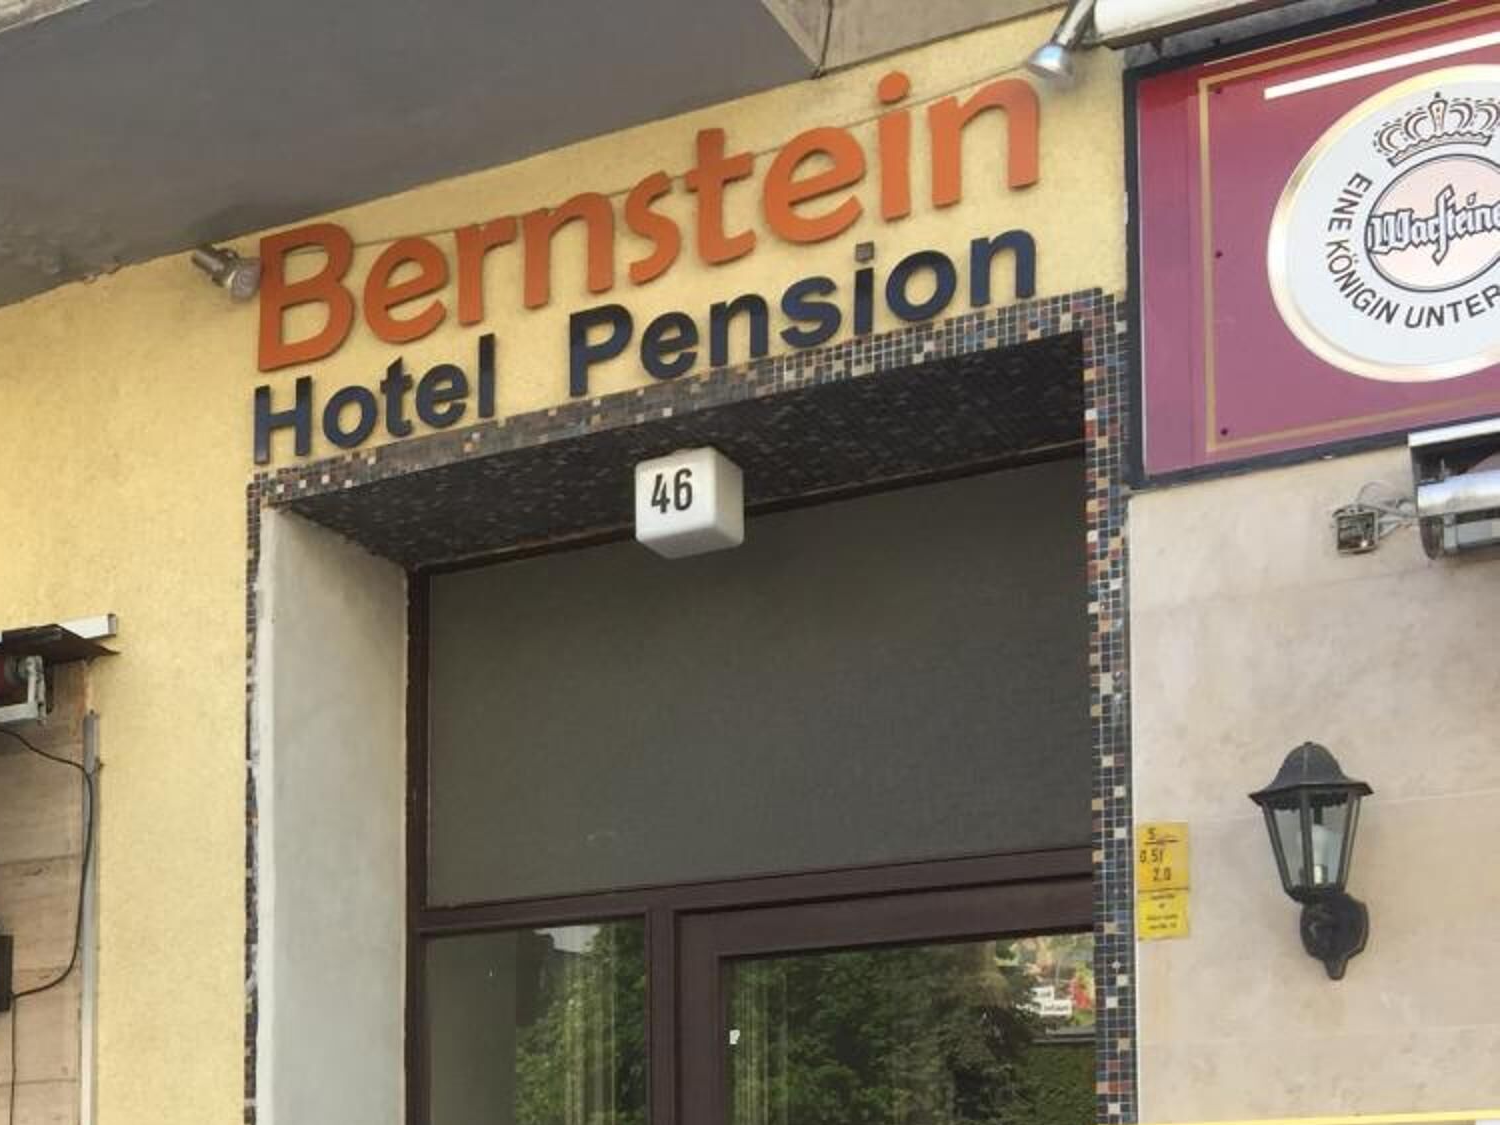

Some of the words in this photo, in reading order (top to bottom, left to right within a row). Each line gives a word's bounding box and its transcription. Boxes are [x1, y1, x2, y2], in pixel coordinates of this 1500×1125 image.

[257, 71, 1041, 372] Bernstein
[1328, 171, 1373, 232] EINE
[1325, 238, 1399, 325] KÖNIGIN
[1404, 283, 1500, 328] UNTER
[254, 334, 496, 465] Hotel
[569, 228, 1038, 398] Pension
[651, 467, 693, 514] 46
